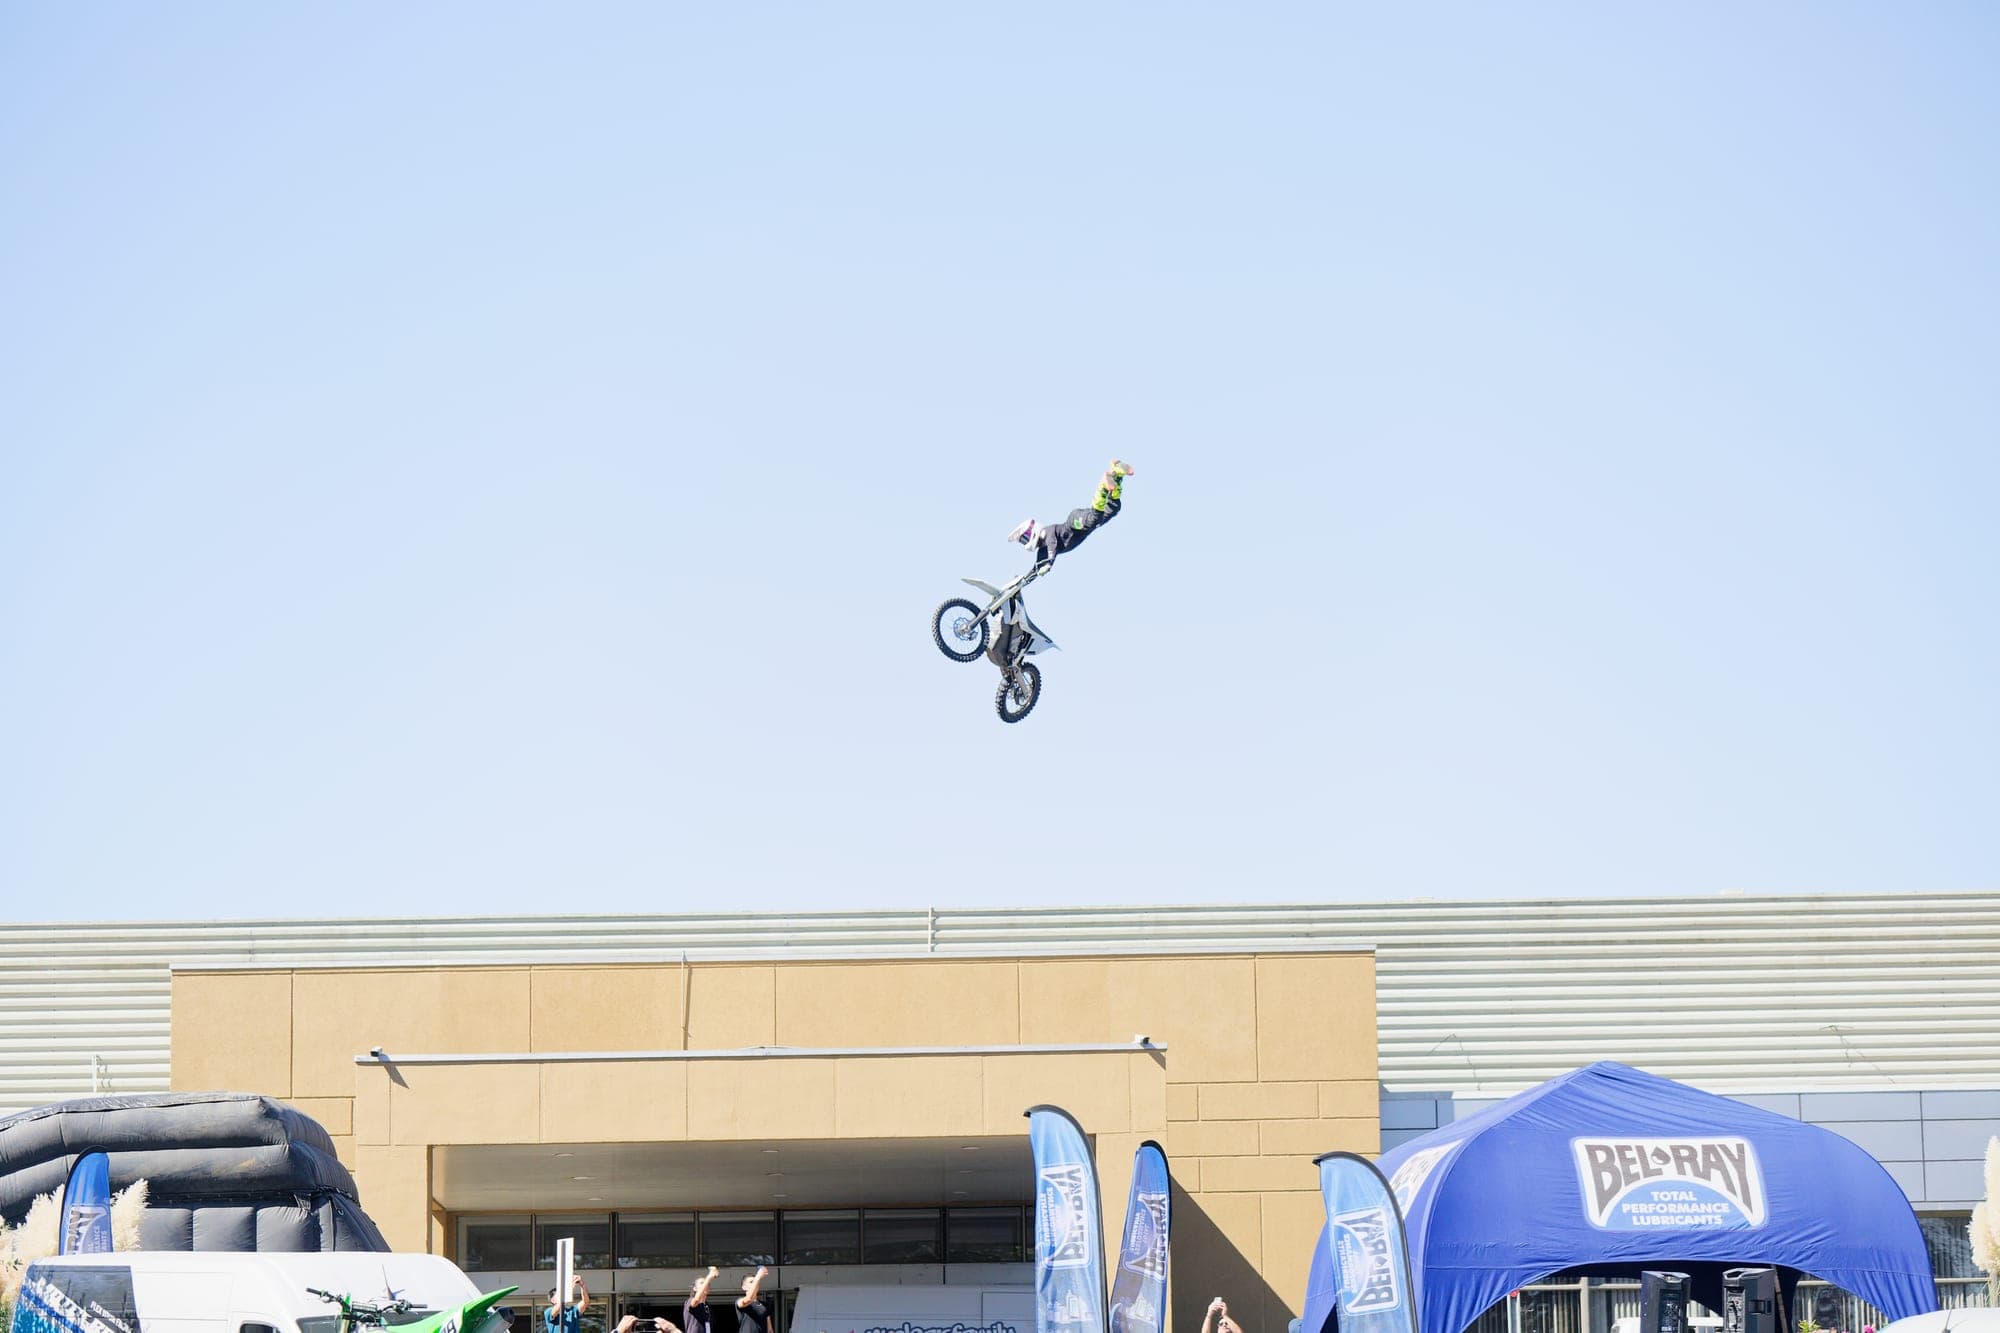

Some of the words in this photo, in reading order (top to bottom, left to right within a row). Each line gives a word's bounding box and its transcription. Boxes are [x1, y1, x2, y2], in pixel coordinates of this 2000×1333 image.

[1650, 1191, 1697, 1201] TOTAL
[1621, 1202, 1730, 1214] PERFORMANCE
[1632, 1215, 1723, 1226] LUBRICANTS
